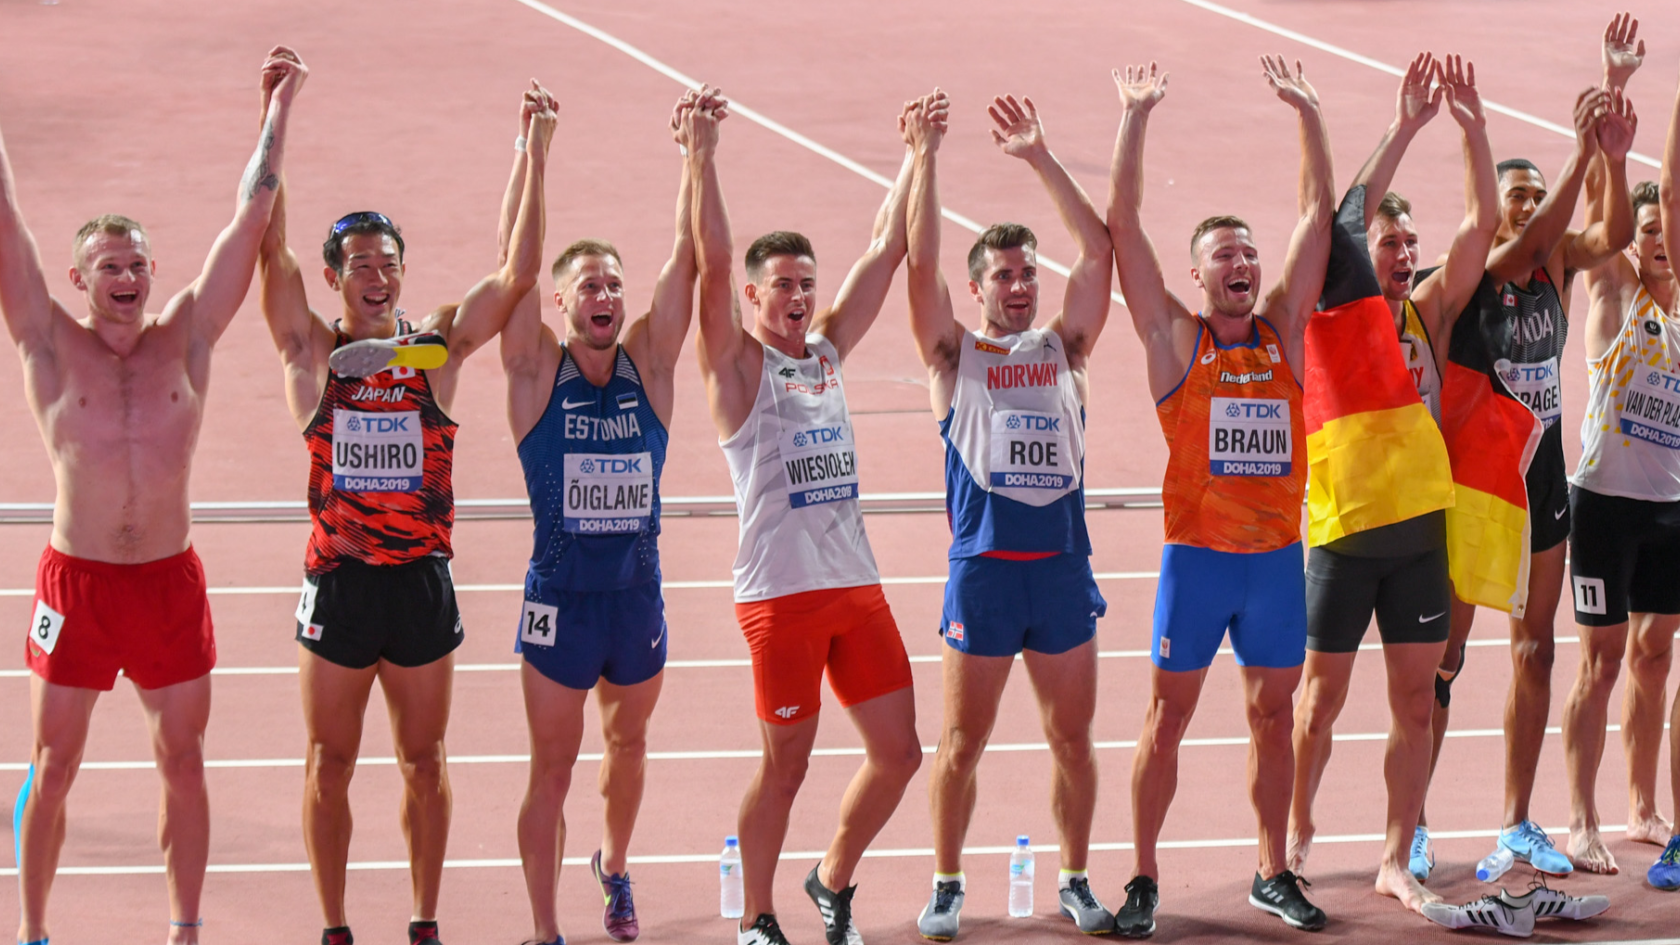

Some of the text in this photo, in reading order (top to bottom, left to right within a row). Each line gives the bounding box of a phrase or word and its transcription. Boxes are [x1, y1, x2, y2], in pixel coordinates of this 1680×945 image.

[987, 362, 1058, 391] NORWAY
[1521, 366, 1553, 382] TDK
[351, 385, 406, 403] JAPAN
[785, 378, 839, 396] POLSKA
[1240, 403, 1281, 419] TDK
[1625, 389, 1646, 417] VAN
[1643, 395, 1664, 423] DER
[361, 416, 409, 433] TDK
[564, 412, 642, 442] ESTONIA
[1021, 414, 1060, 432] TDK
[805, 425, 844, 445] TDK
[1214, 427, 1287, 455] BRAUN
[336, 441, 417, 470] USHIRO
[1009, 440, 1058, 467] ROE
[595, 458, 642, 474] TDK
[1223, 461, 1282, 475] DOHA2019
[344, 477, 410, 491] DOHA2019
[1004, 473, 1064, 488] DOHA2019
[568, 479, 649, 511] ÕIGLANE
[579, 518, 640, 533] DOHA2019
[1580, 584, 1598, 608] 11
[37, 614, 52, 641] 8
[527, 610, 552, 638] 14
